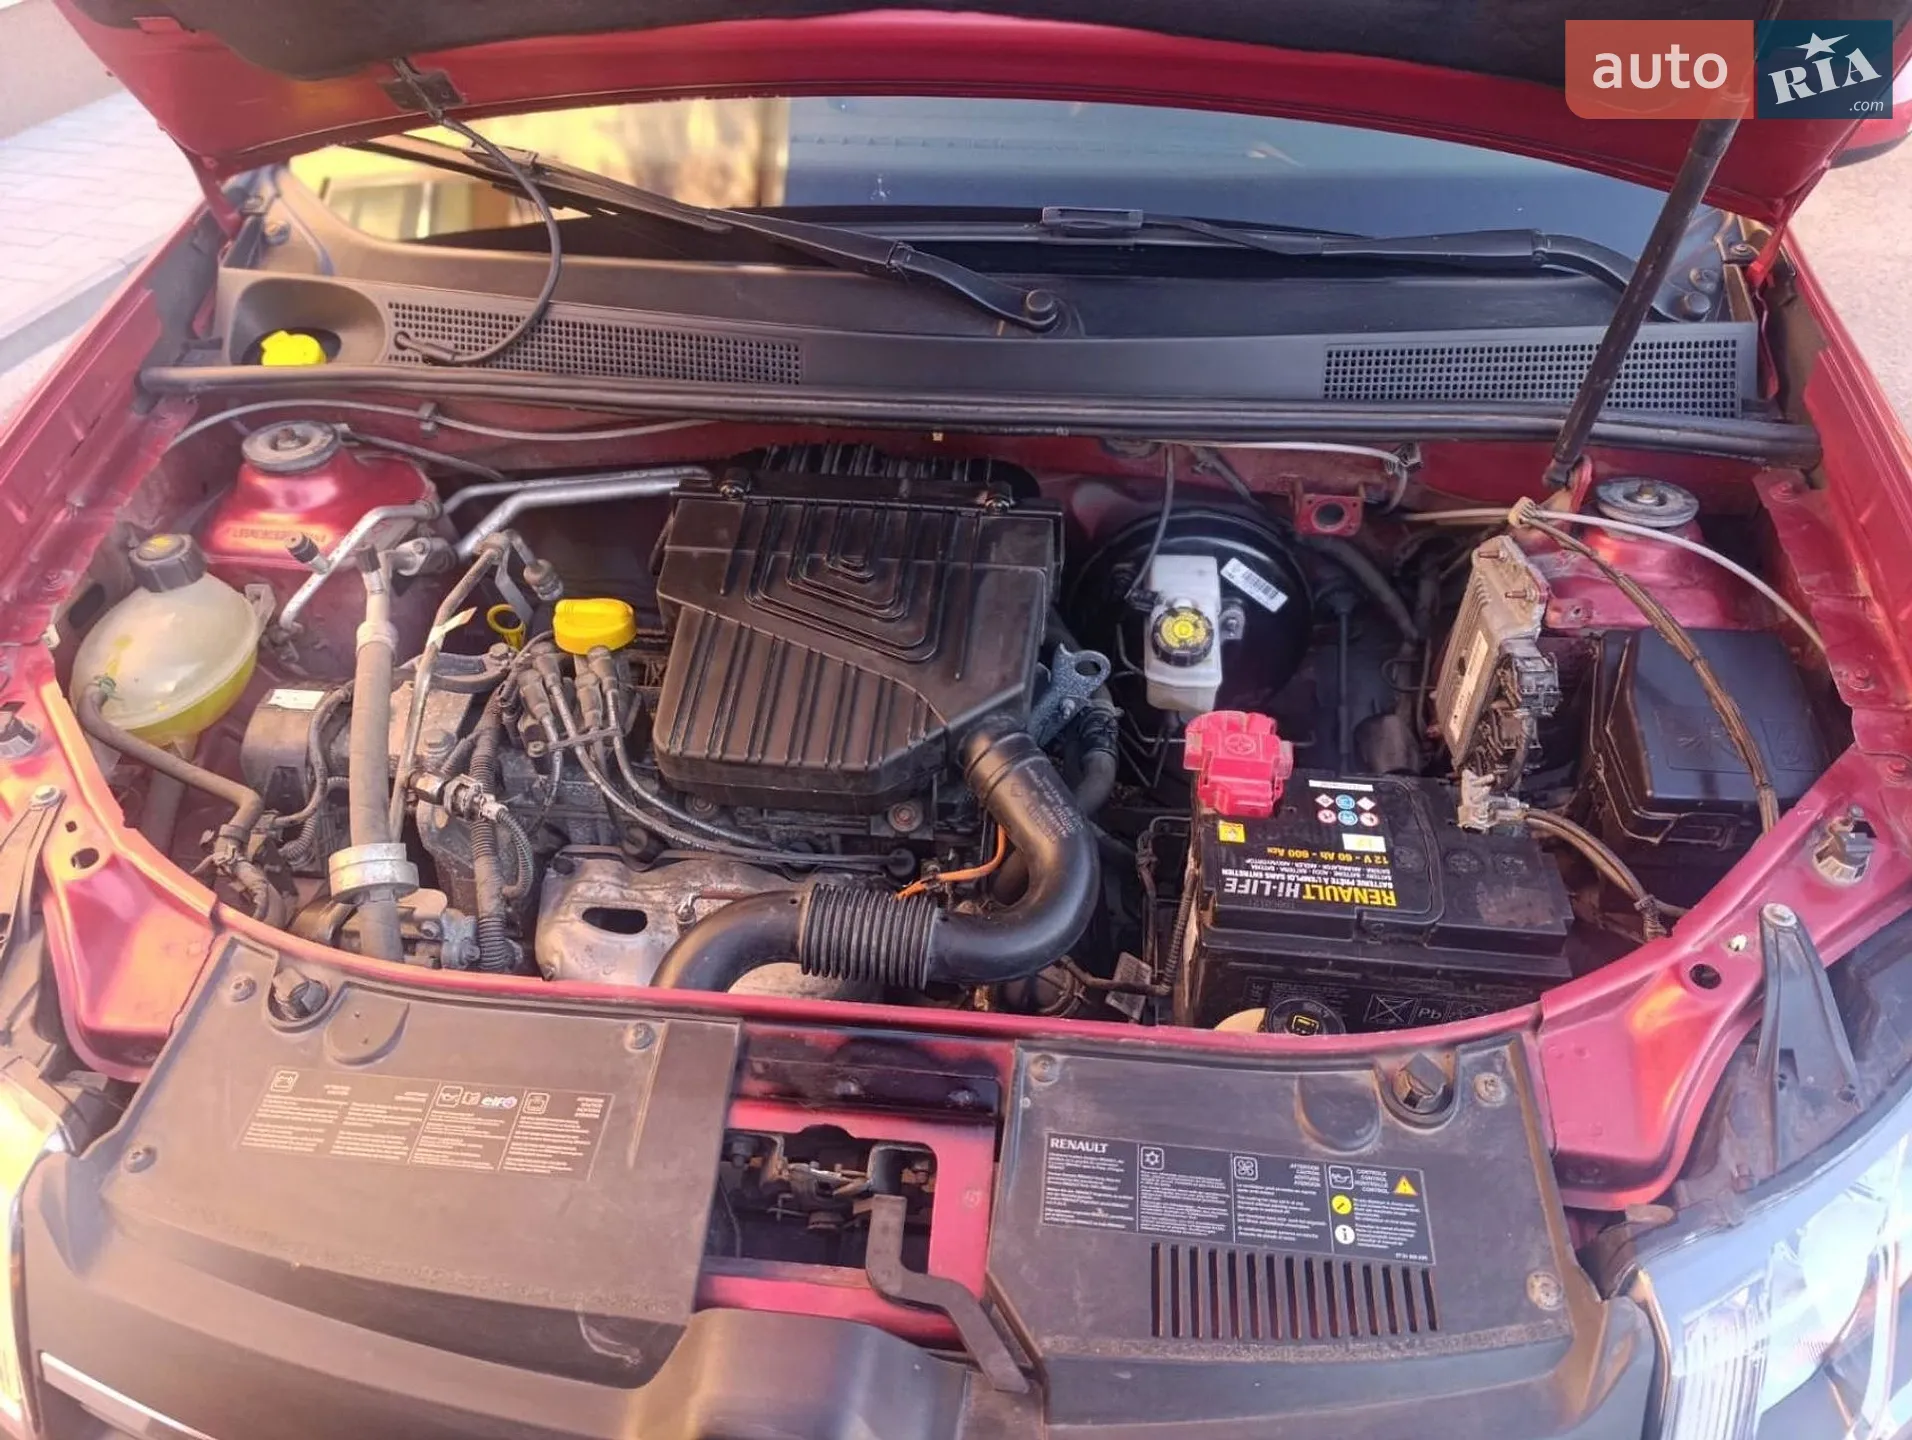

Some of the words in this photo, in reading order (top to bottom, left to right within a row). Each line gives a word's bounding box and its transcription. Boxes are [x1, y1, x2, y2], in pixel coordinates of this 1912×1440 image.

[1302, 884, 1397, 906] RENAULT
[1417, 1007, 1442, 1020] Pb
[1049, 1138, 1109, 1153] RENAULT
